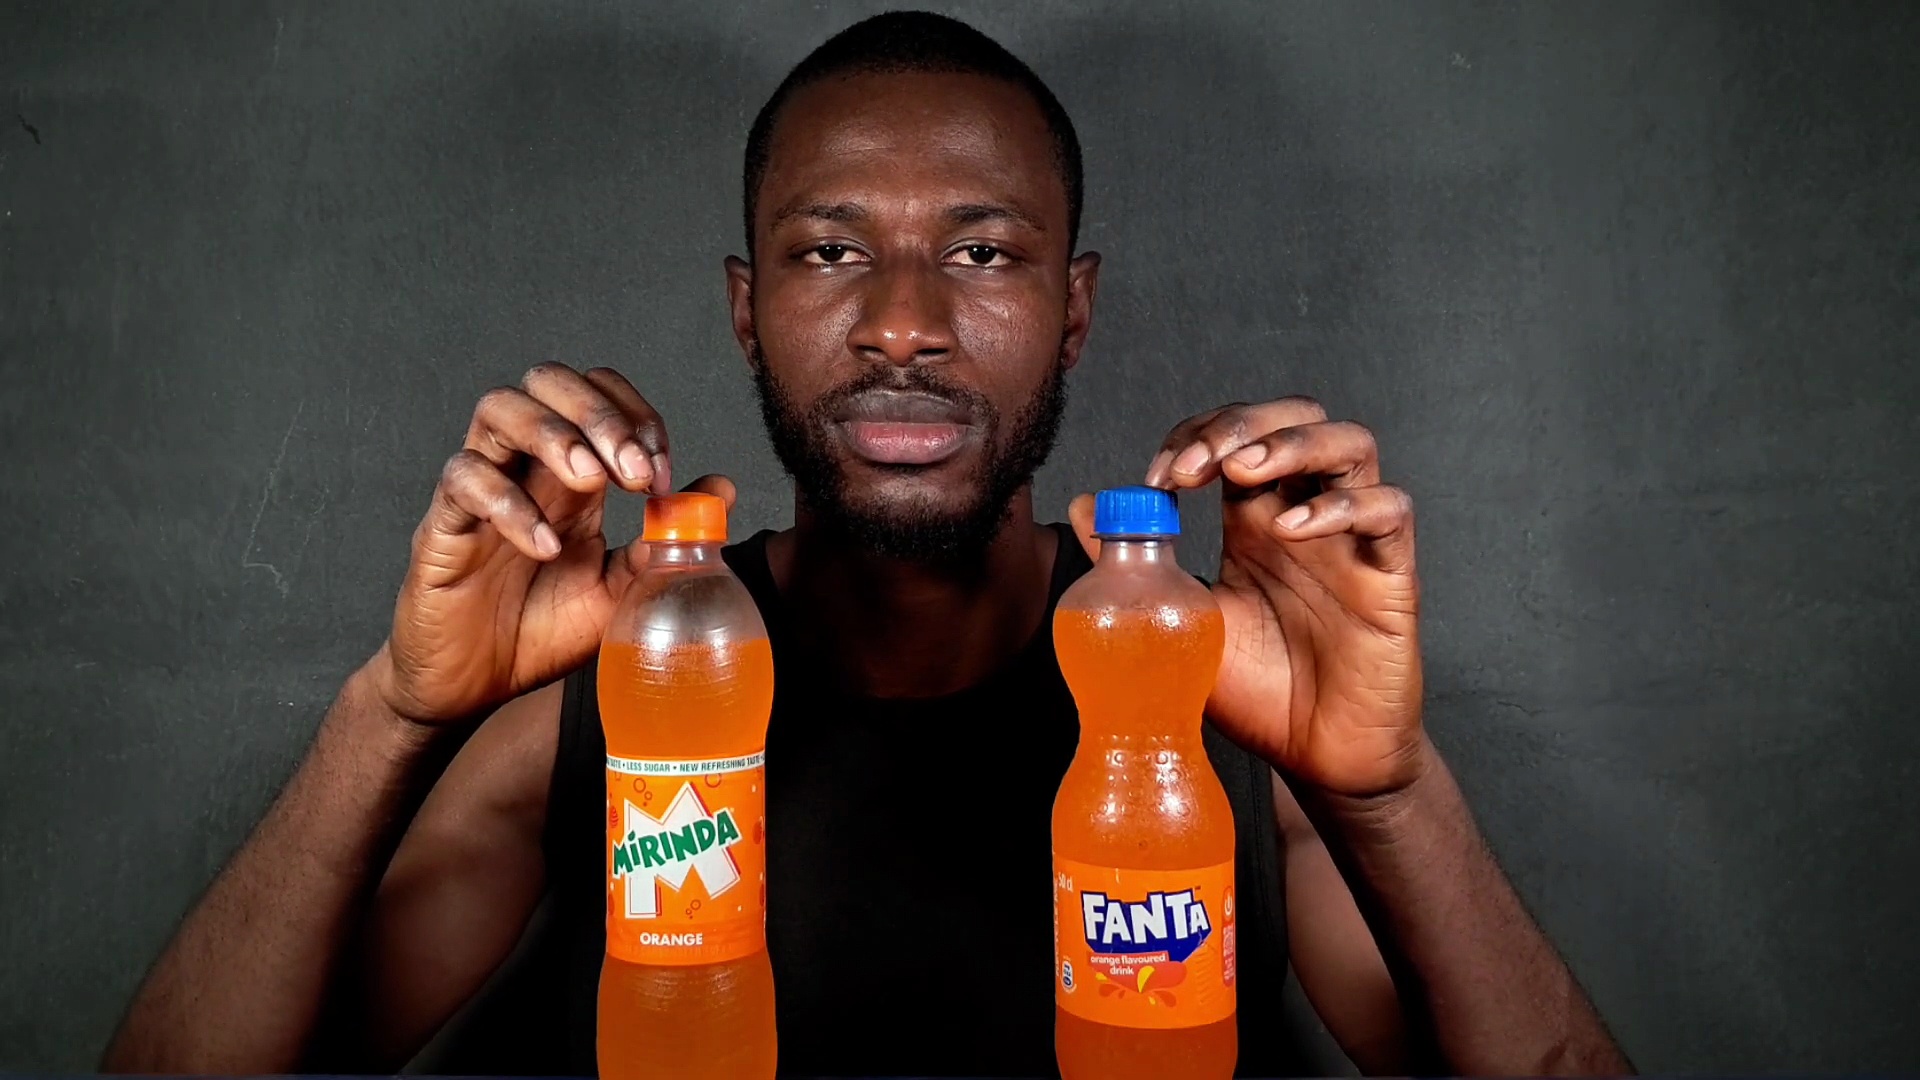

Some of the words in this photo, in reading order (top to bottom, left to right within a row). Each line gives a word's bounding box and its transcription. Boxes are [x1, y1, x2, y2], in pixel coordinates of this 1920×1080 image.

[626, 761, 642, 771] LESS
[644, 763, 671, 772] SUGAR
[679, 763, 699, 772] NEW
[701, 758, 746, 771] REFRESHING
[1082, 891, 1209, 944] FANTA
[639, 932, 703, 946] ORANGE
[1090, 956, 1120, 966] orange
[1121, 954, 1166, 964] flavoured
[1109, 965, 1134, 975] drink
